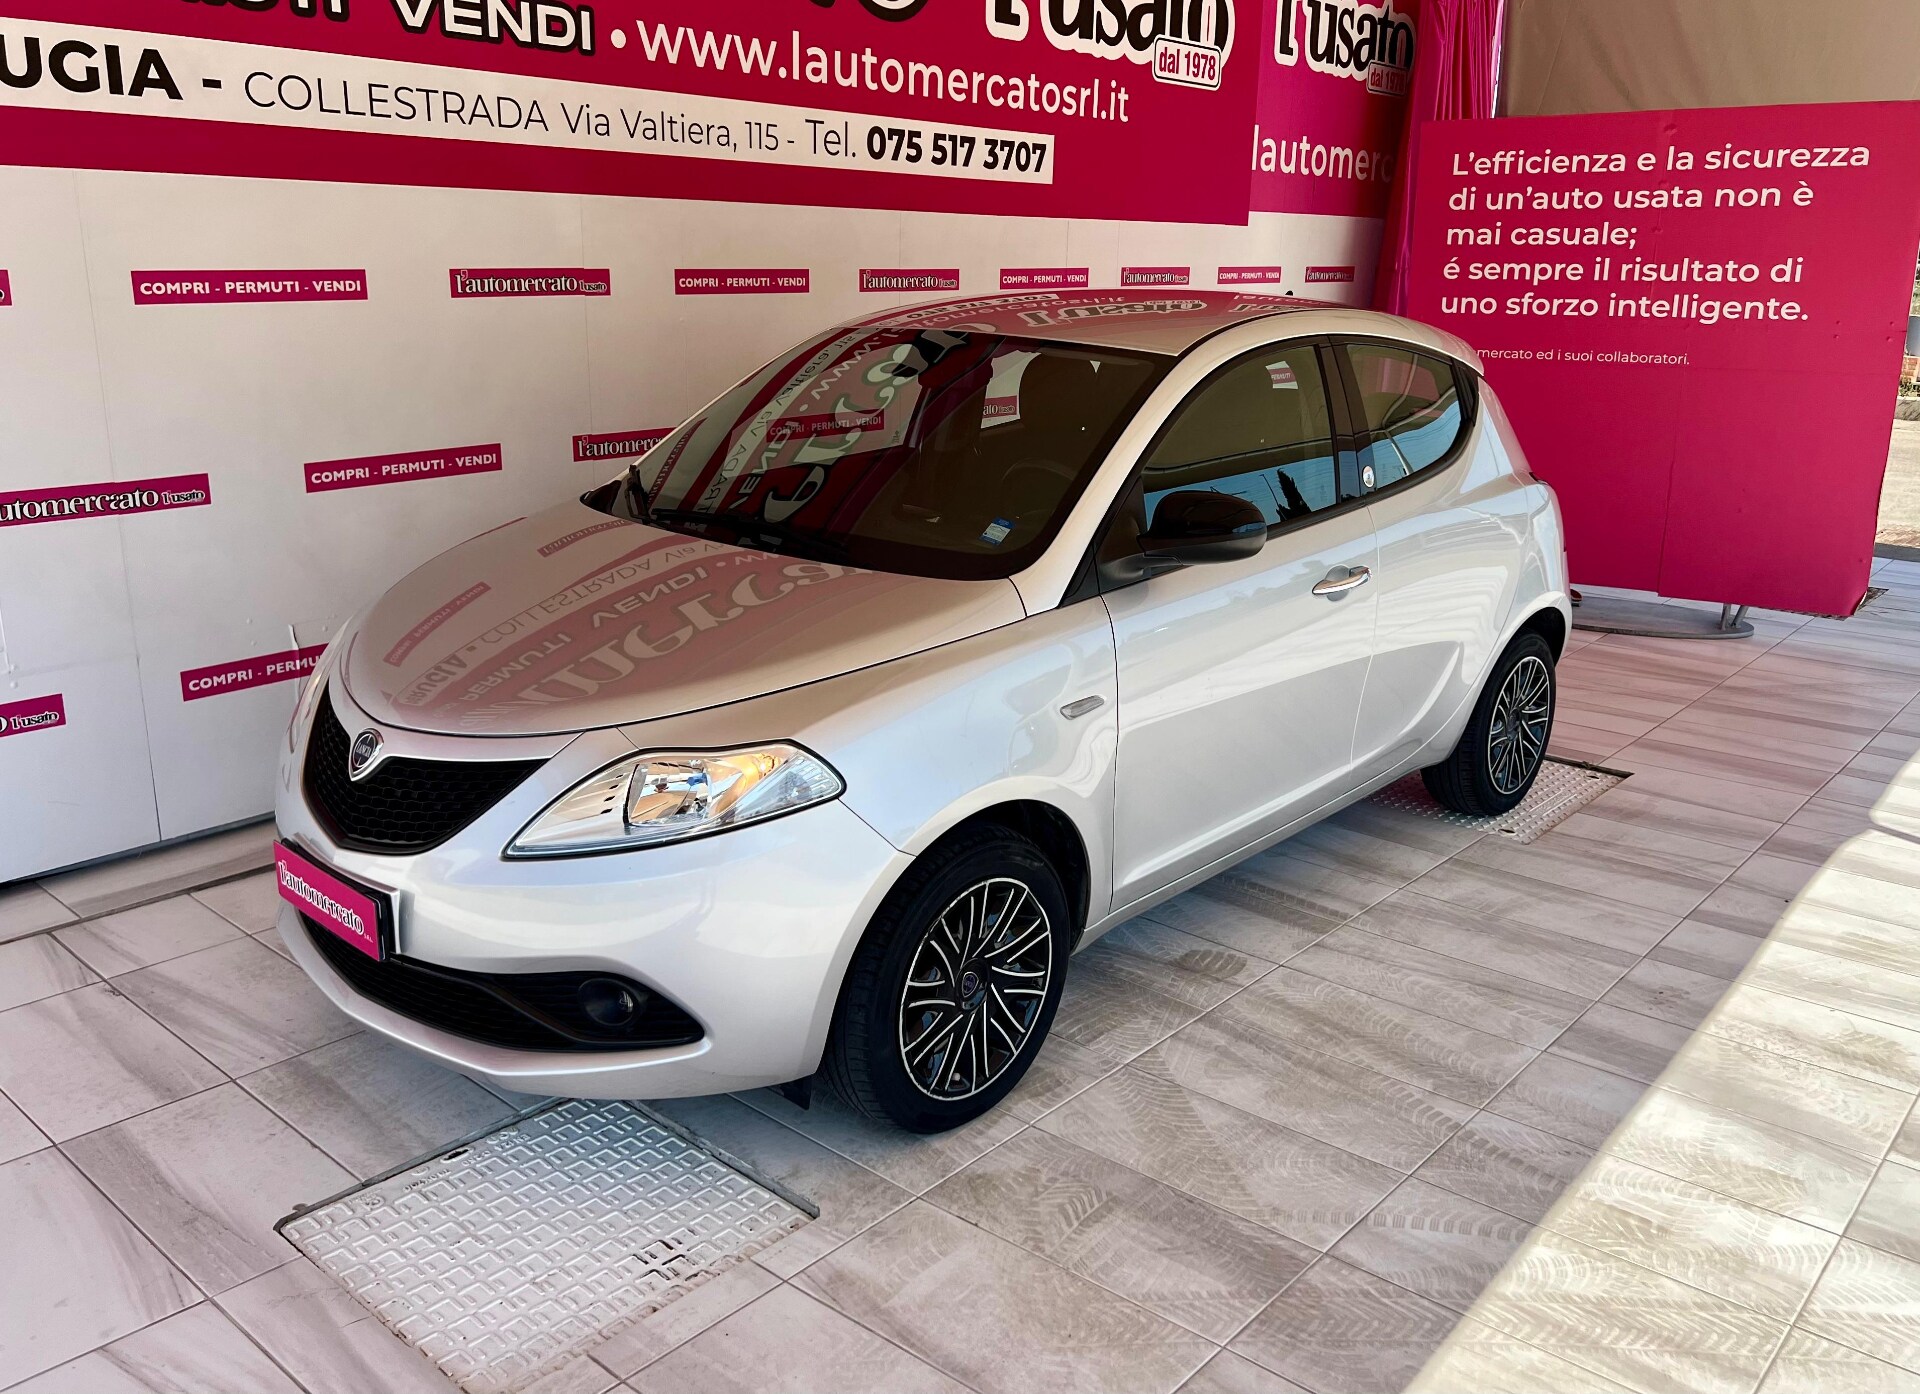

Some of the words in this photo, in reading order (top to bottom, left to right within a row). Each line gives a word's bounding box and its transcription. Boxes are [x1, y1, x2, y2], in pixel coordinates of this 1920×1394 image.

[636, 20, 1129, 122] www.lautomercatosrl.it
[1158, 46, 1180, 75] dal
[1184, 50, 1217, 81] 1978
[244, 71, 550, 132] COLLESTRADA
[560, 102, 611, 138] Via
[620, 108, 738, 153] Valtiera,
[745, 121, 779, 151] 115
[804, 119, 857, 158] Tel.
[867, 125, 922, 163] 075
[931, 132, 976, 167] 517
[983, 138, 1047, 173] 3707
[1452, 149, 1627, 176] L'efficienza
[1636, 152, 1656, 172] e
[1666, 146, 1695, 171] la
[1704, 143, 1870, 170] sicurezza
[1449, 186, 1477, 211] di
[1485, 186, 1603, 210] un'auto
[1613, 186, 1703, 209] usata
[1714, 187, 1781, 207] non
[1792, 180, 1815, 207] è
[1446, 222, 1502, 247] mai
[1510, 221, 1638, 250] casuale;
[454, 270, 578, 294] l'automercato
[679, 277, 719, 288] COMPRI
[726, 277, 771, 288] PERMUTI
[777, 276, 806, 287] VENDI
[863, 269, 938, 289] l'automercato
[1002, 275, 1029, 284] COMPRI
[1033, 274, 1064, 284] PERMUTI
[1067, 274, 1087, 283] VENDI
[1468, 261, 1584, 286] sempre
[1593, 256, 1611, 282] il
[1620, 256, 1760, 283] risultato
[1769, 256, 1804, 283] di
[139, 282, 211, 296] COMPRI
[224, 281, 300, 295] PERMUTI
[312, 280, 361, 293] VENDI
[1441, 296, 1498, 314] uno
[1505, 291, 1599, 316] sforzo
[1608, 292, 1809, 326] intelligente.
[1536, 349, 1554, 360] ed
[1564, 350, 1594, 362] suoi
[1596, 350, 1690, 365] collaboratori.
[770, 425, 804, 436] COMPRI
[811, 420, 850, 431] PERMUTI
[856, 416, 881, 426] VENDI
[577, 435, 664, 457] l'automerc
[311, 468, 370, 484] COMPRI
[381, 459, 445, 476] PERMUTI
[455, 453, 497, 467] VENDI
[188, 669, 253, 691] COMPRI
[266, 655, 322, 676] PERMU
[278, 859, 364, 935] l'automercato
